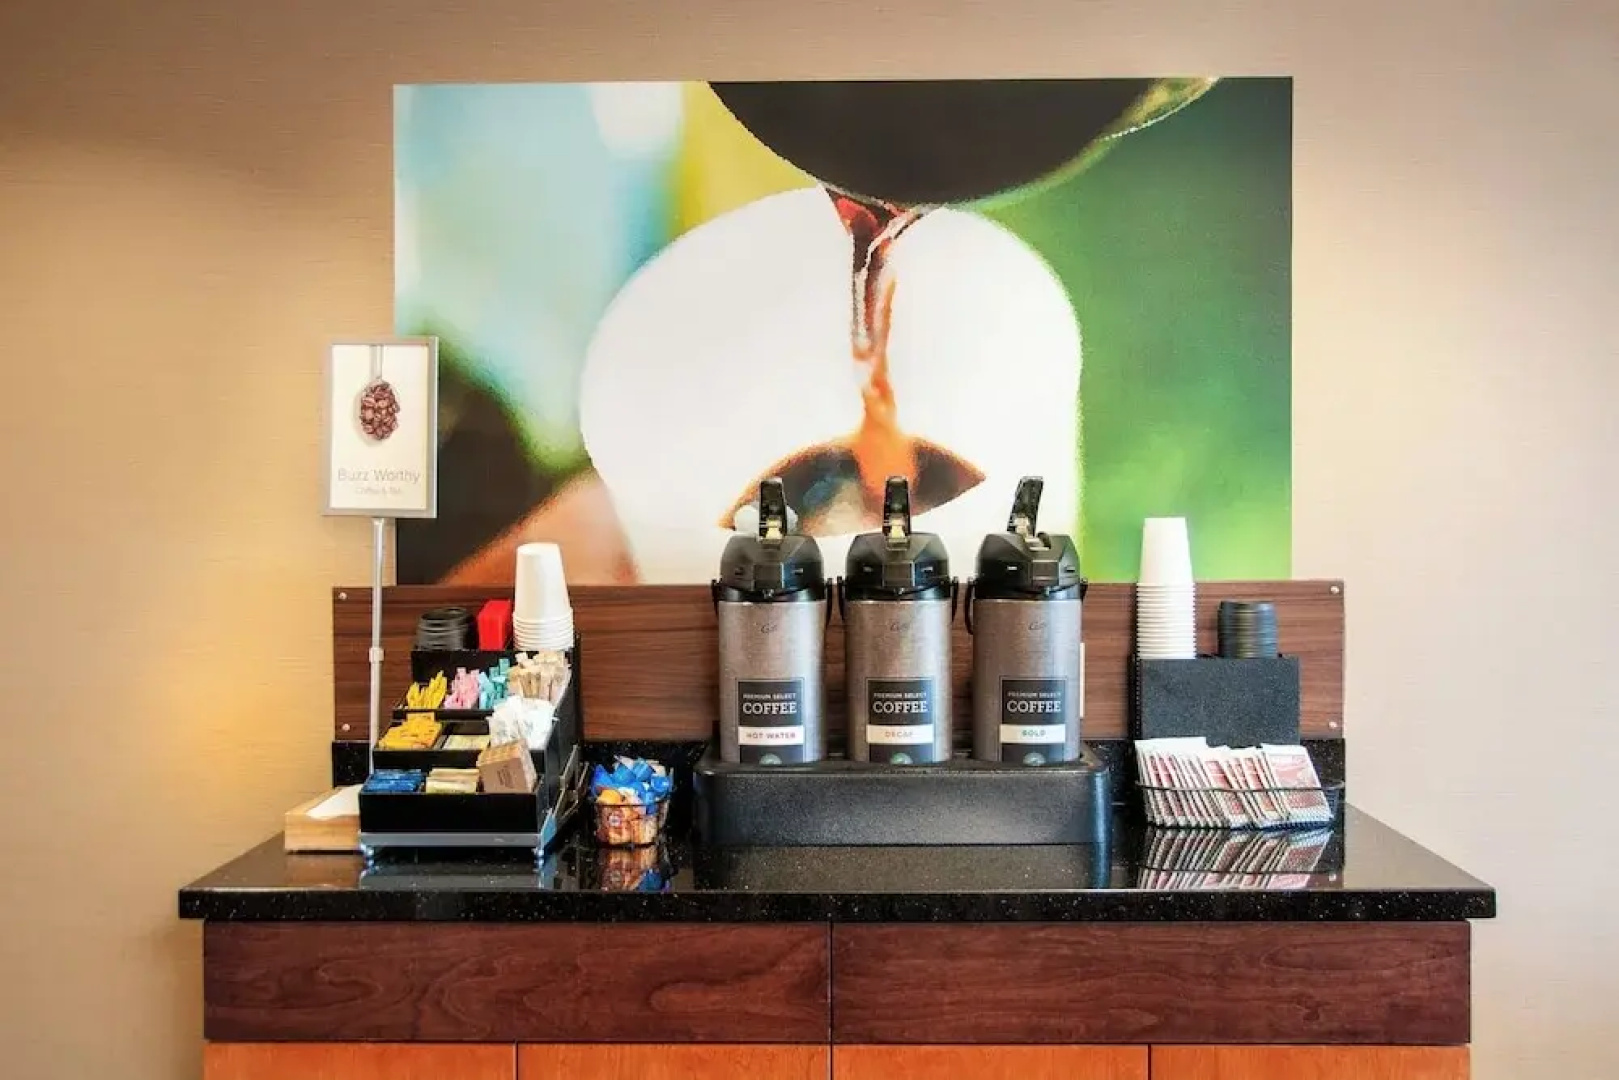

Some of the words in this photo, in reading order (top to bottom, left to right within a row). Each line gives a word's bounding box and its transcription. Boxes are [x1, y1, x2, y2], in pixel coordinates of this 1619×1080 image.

[337, 467, 369, 482] Buzz
[373, 468, 421, 484] Worthy
[773, 692, 797, 700] SELECT
[742, 701, 798, 715] COFFEE
[872, 700, 929, 714] COFFEE
[1006, 700, 1062, 714] COFFEE
[746, 731, 764, 739] HOT
[766, 731, 796, 739] WATER
[884, 730, 914, 738] DECAF
[1021, 729, 1047, 737] BOLD
